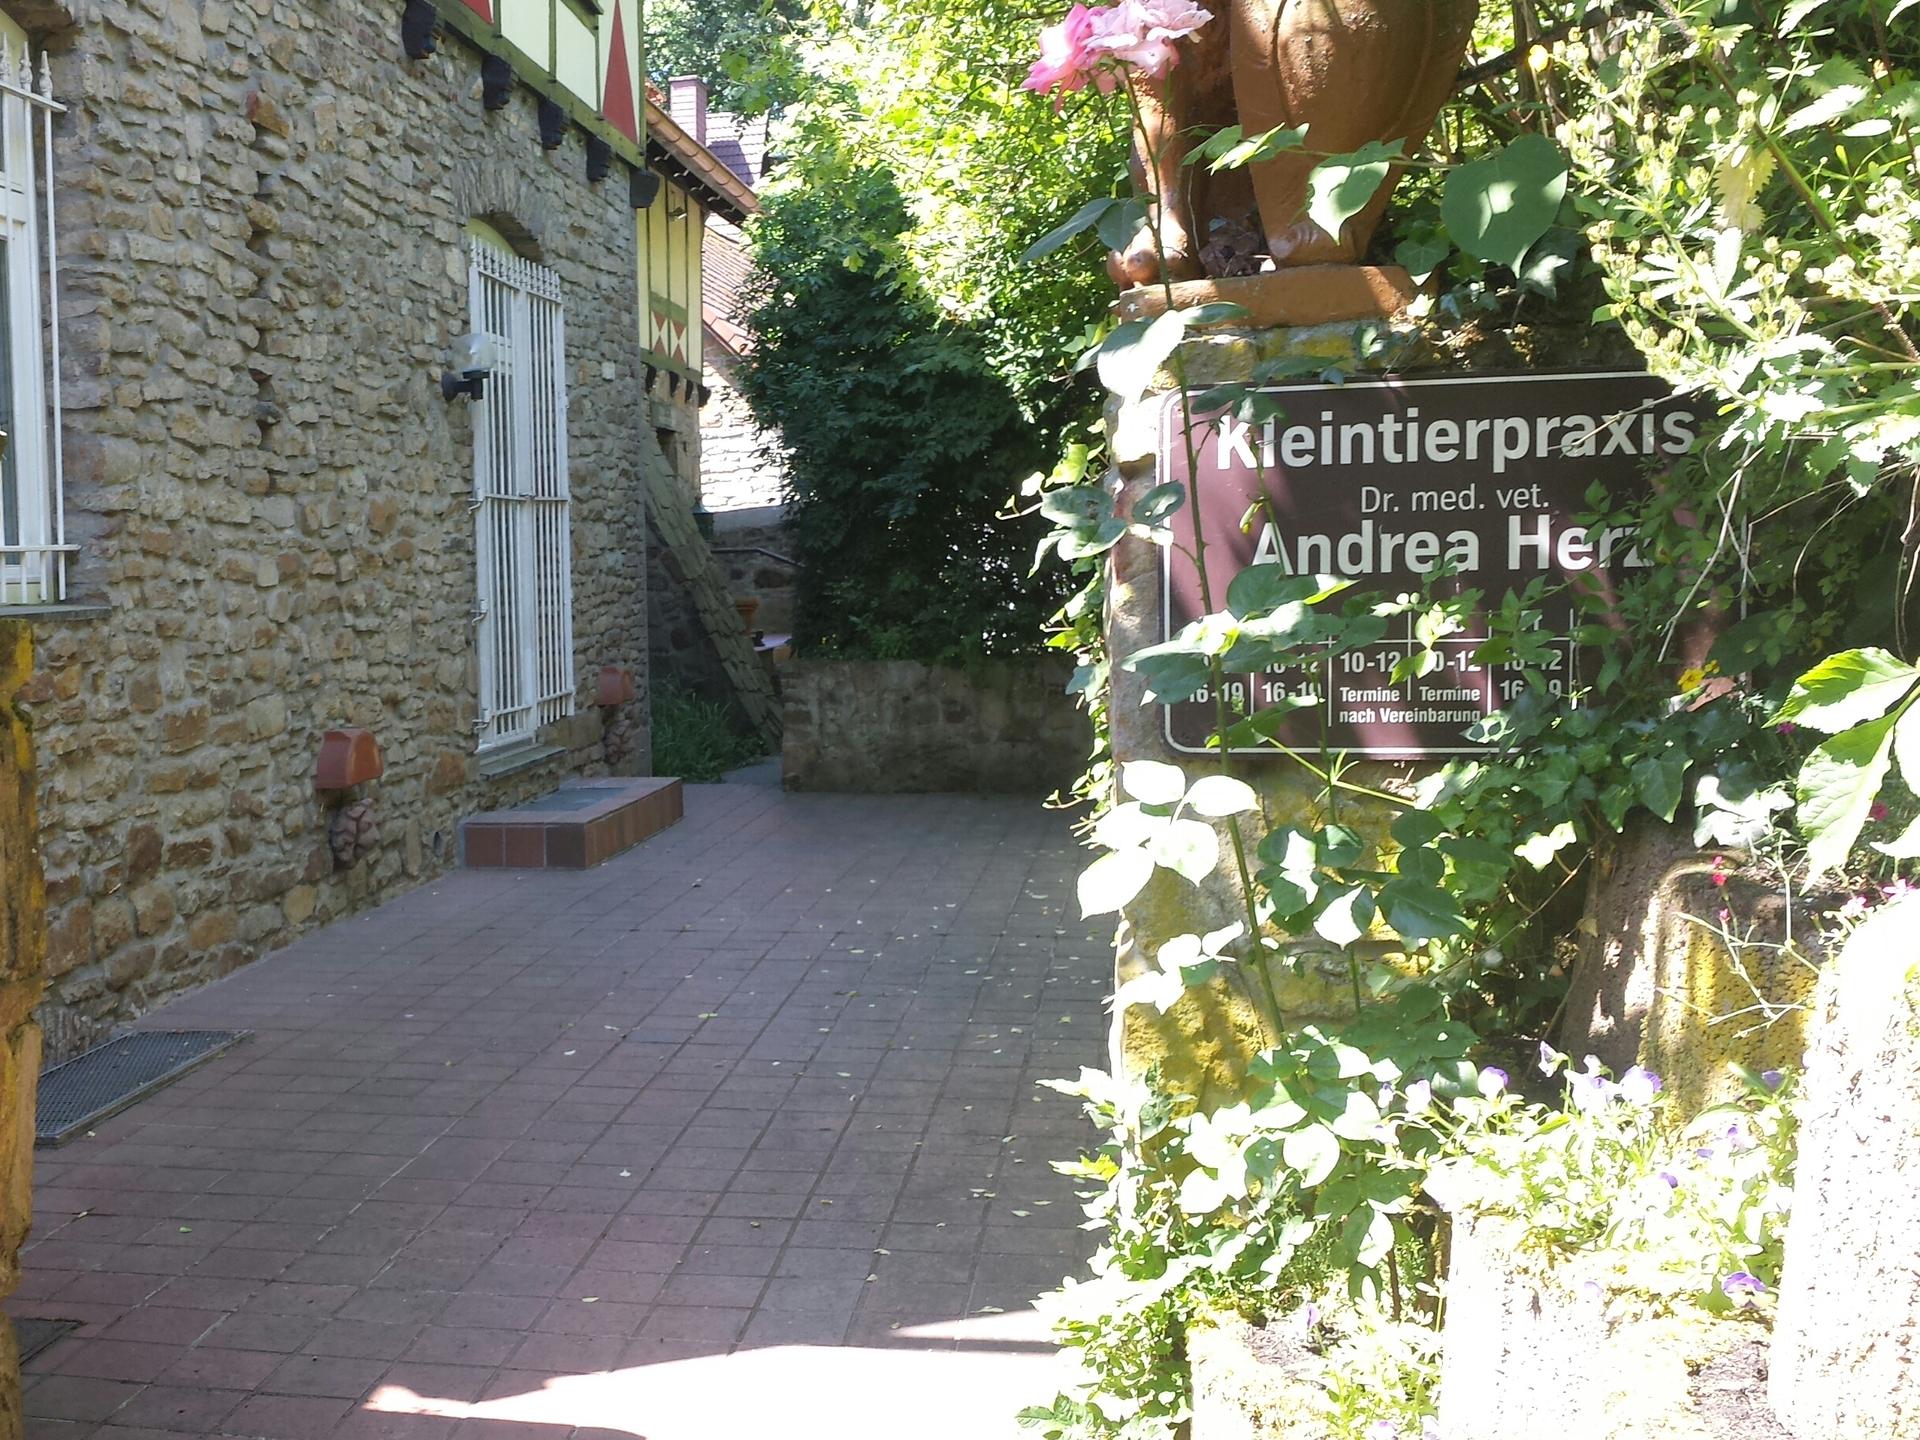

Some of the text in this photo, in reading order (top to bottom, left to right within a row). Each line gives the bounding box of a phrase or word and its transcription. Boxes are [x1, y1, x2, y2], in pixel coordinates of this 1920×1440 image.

[1217, 398, 1696, 473] Kleintierpraxis
[1361, 483, 1550, 513] Dr. med. vet.
[1252, 514, 1655, 576] Andrea Herz
[1339, 651, 1401, 673] 10-12
[1433, 650, 1482, 672] 0-12
[1339, 686, 1401, 702] Termine
[1419, 685, 1481, 702] Termine
[1499, 679, 1562, 701] 169
[1339, 706, 1481, 724] nach Vereinbarung
